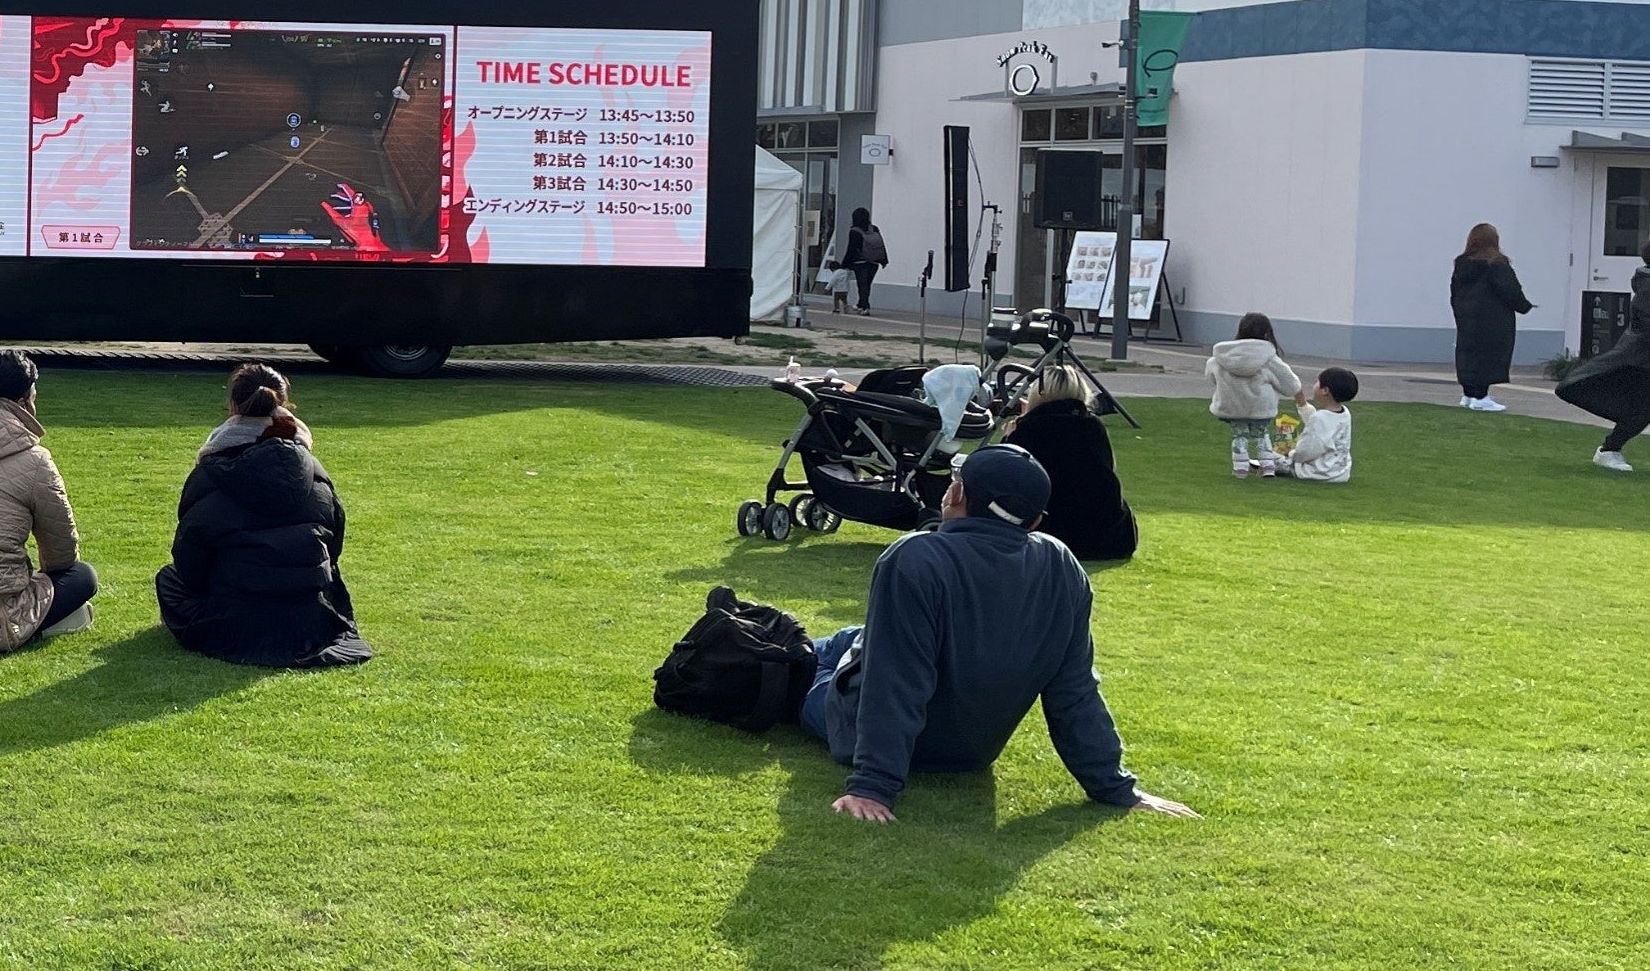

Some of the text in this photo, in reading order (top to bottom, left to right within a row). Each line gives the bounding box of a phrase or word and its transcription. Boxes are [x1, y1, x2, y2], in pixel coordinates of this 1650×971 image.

[476, 61, 692, 87] TIME SCHEDULE
[467, 106, 588, 122] オープニングステージ
[534, 129, 588, 146] 第1試合
[533, 153, 587, 168] 第2試合
[533, 176, 587, 192] 第3試合
[465, 199, 586, 215] エンディングステージ
